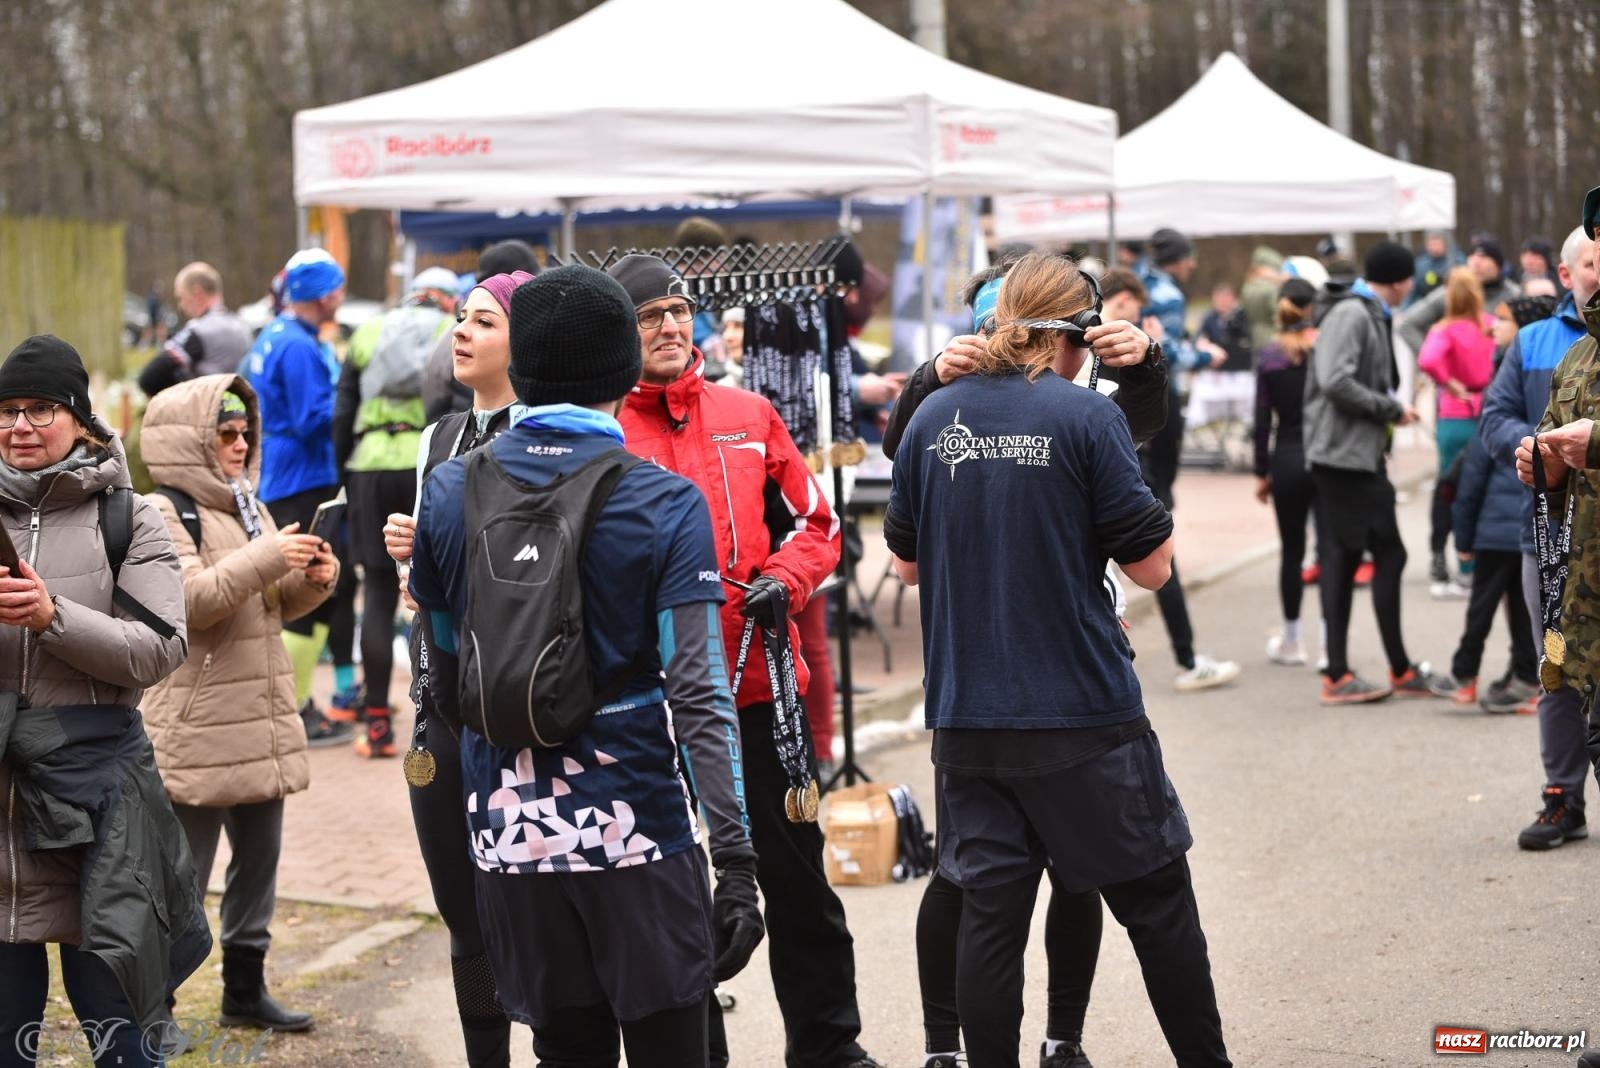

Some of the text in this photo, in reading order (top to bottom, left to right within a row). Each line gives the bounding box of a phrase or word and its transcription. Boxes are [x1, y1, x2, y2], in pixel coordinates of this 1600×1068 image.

[711, 432, 748, 442] SPYDER
[948, 435, 1053, 450] OKTAN ENERGY
[969, 447, 1051, 460] & V/L SERVICE
